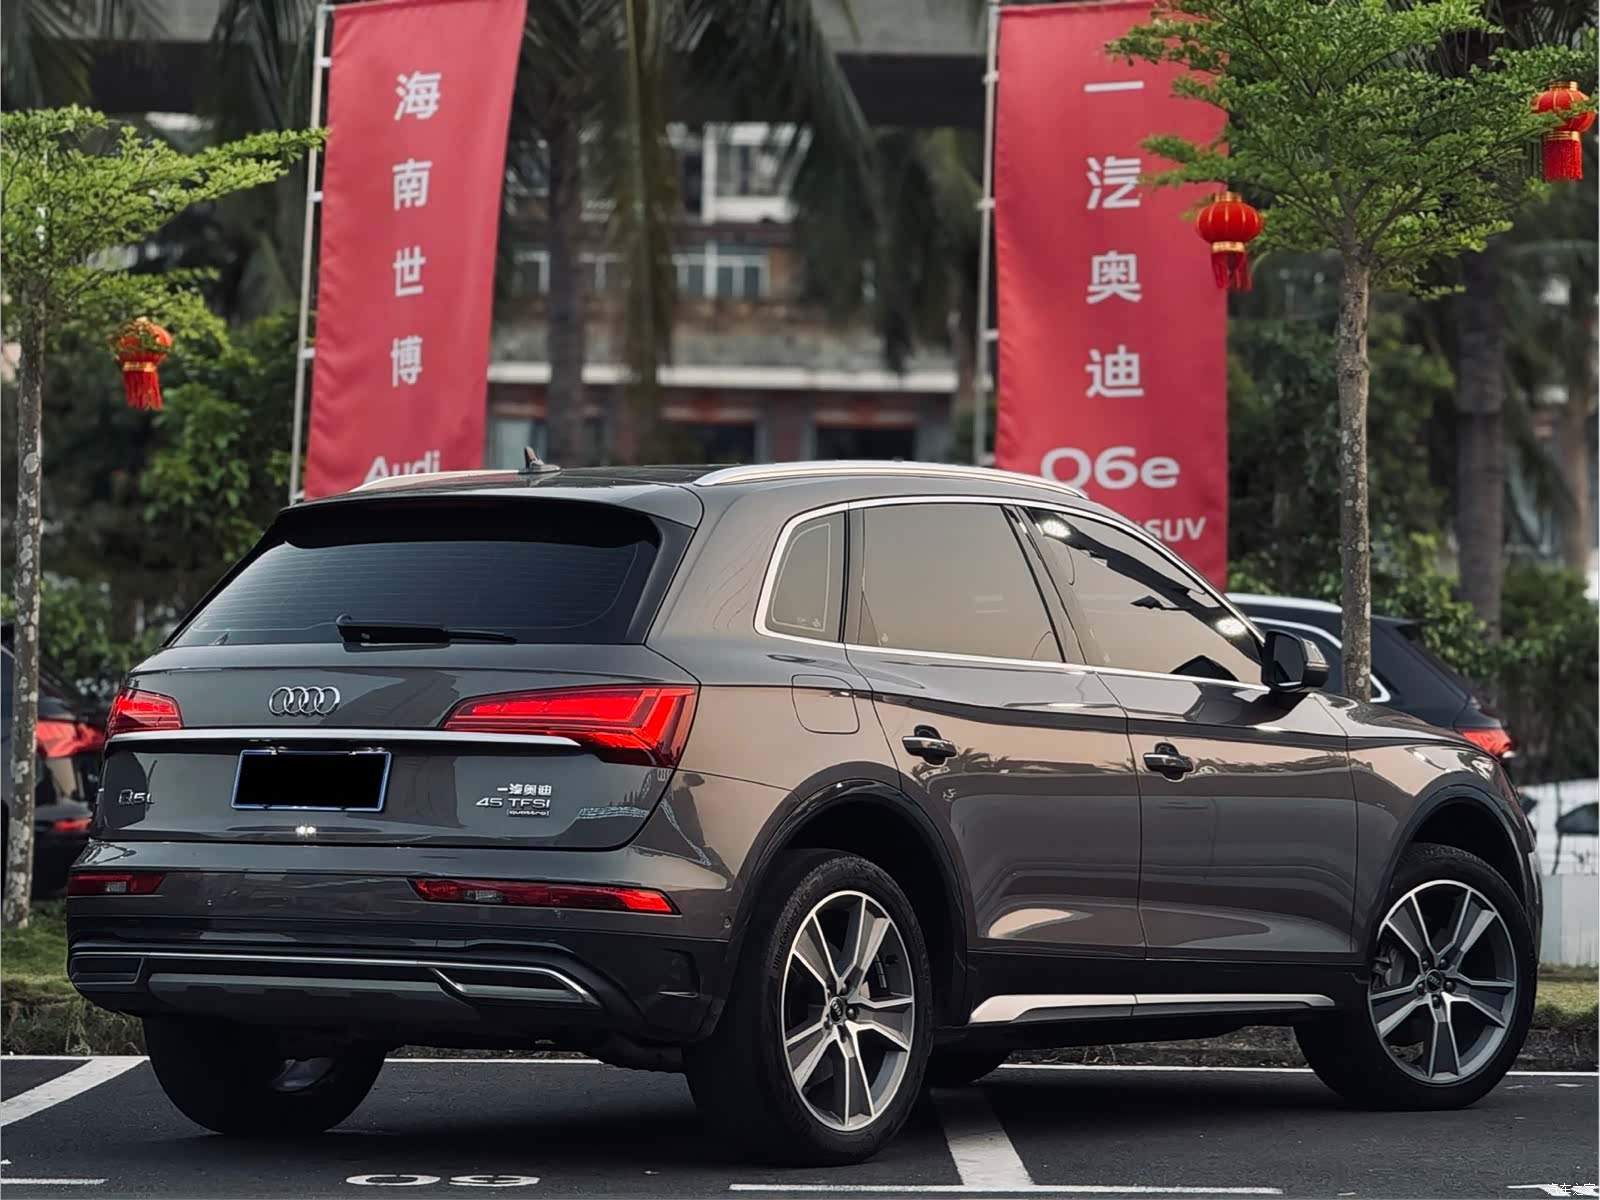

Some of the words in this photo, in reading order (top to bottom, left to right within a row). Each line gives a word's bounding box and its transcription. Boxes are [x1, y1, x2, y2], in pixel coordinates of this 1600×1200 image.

[390, 70, 442, 387] 海南世博
[1083, 80, 1144, 398] 一汽奥迪
[1040, 446, 1180, 495] Q6e
[118, 788, 155, 805] Q5L
[475, 797, 503, 807] 45
[508, 798, 551, 808] TFSI
